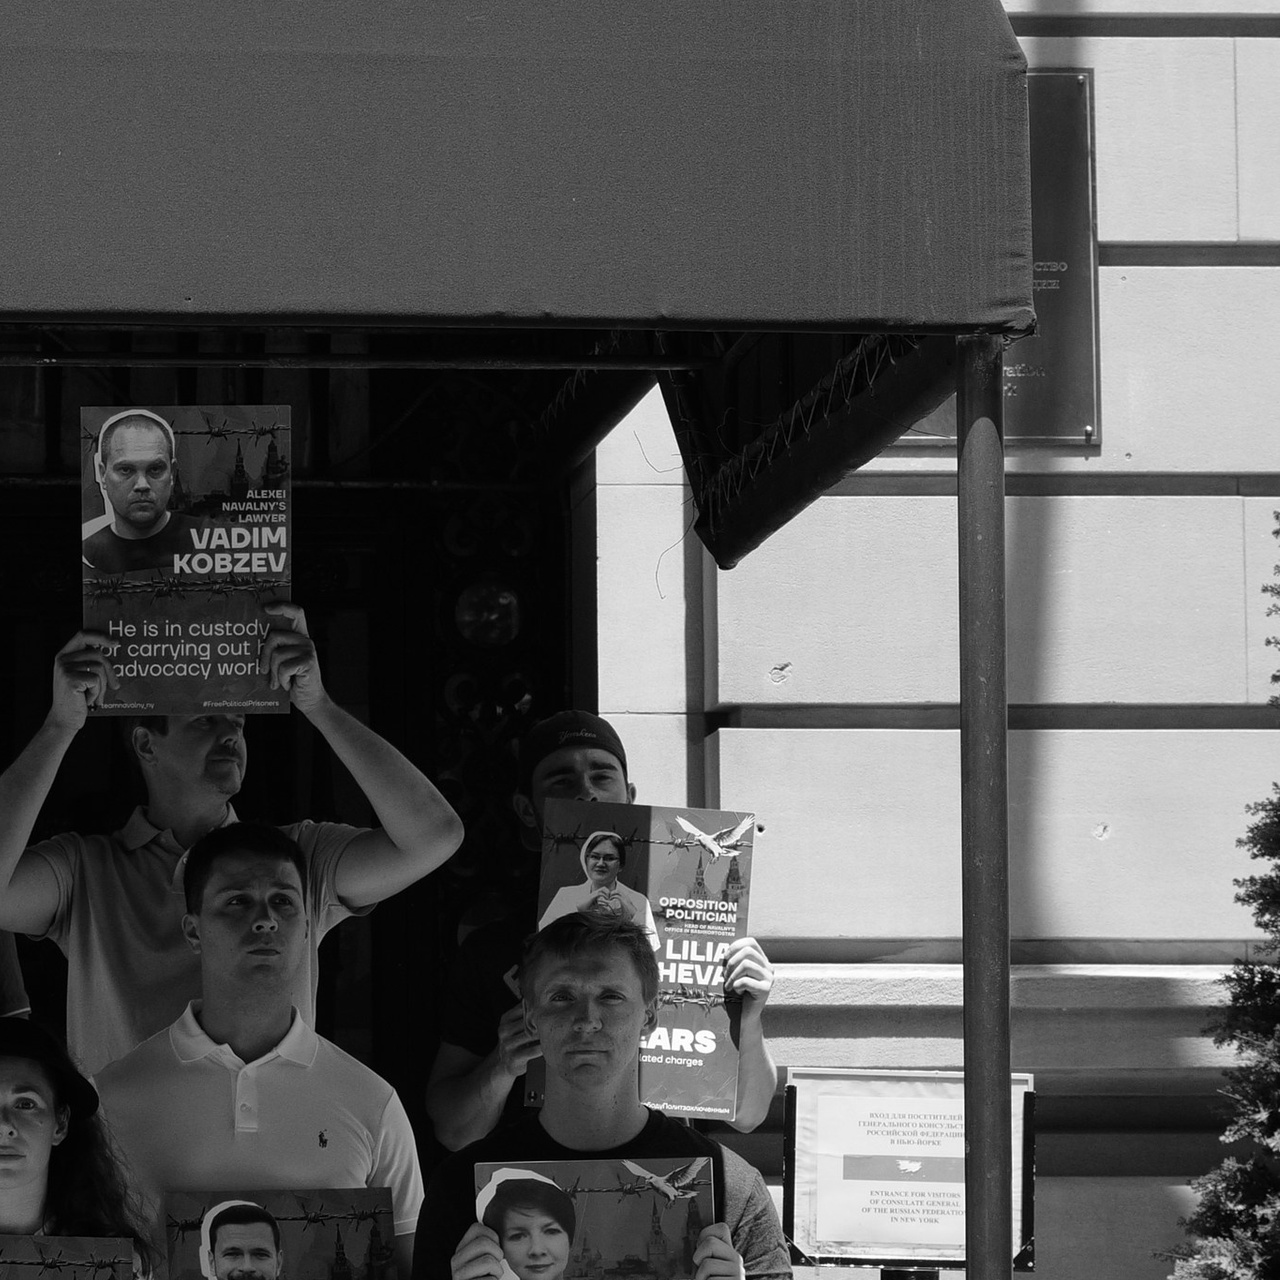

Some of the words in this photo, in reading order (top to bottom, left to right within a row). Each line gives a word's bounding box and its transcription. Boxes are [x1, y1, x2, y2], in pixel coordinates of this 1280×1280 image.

[246, 489, 286, 499] ALEXEI
[222, 501, 286, 511] NAVALNY'S
[238, 513, 286, 523] LAWYER
[190, 526, 287, 549] VADIM
[173, 552, 287, 575] KOBZEV
[109, 620, 136, 637] He
[143, 620, 158, 636] is
[165, 620, 183, 636] in
[188, 619, 270, 640] custody
[127, 639, 210, 660] carrying
[216, 639, 251, 656] out
[113, 660, 212, 680] advocacy
[659, 896, 738, 912] OPPOSITION
[666, 909, 737, 923] POLITICIAN
[666, 939, 731, 962] LILIA
[665, 1056, 703, 1067] charges
[881, 1199, 924, 1207] CONSULATE
